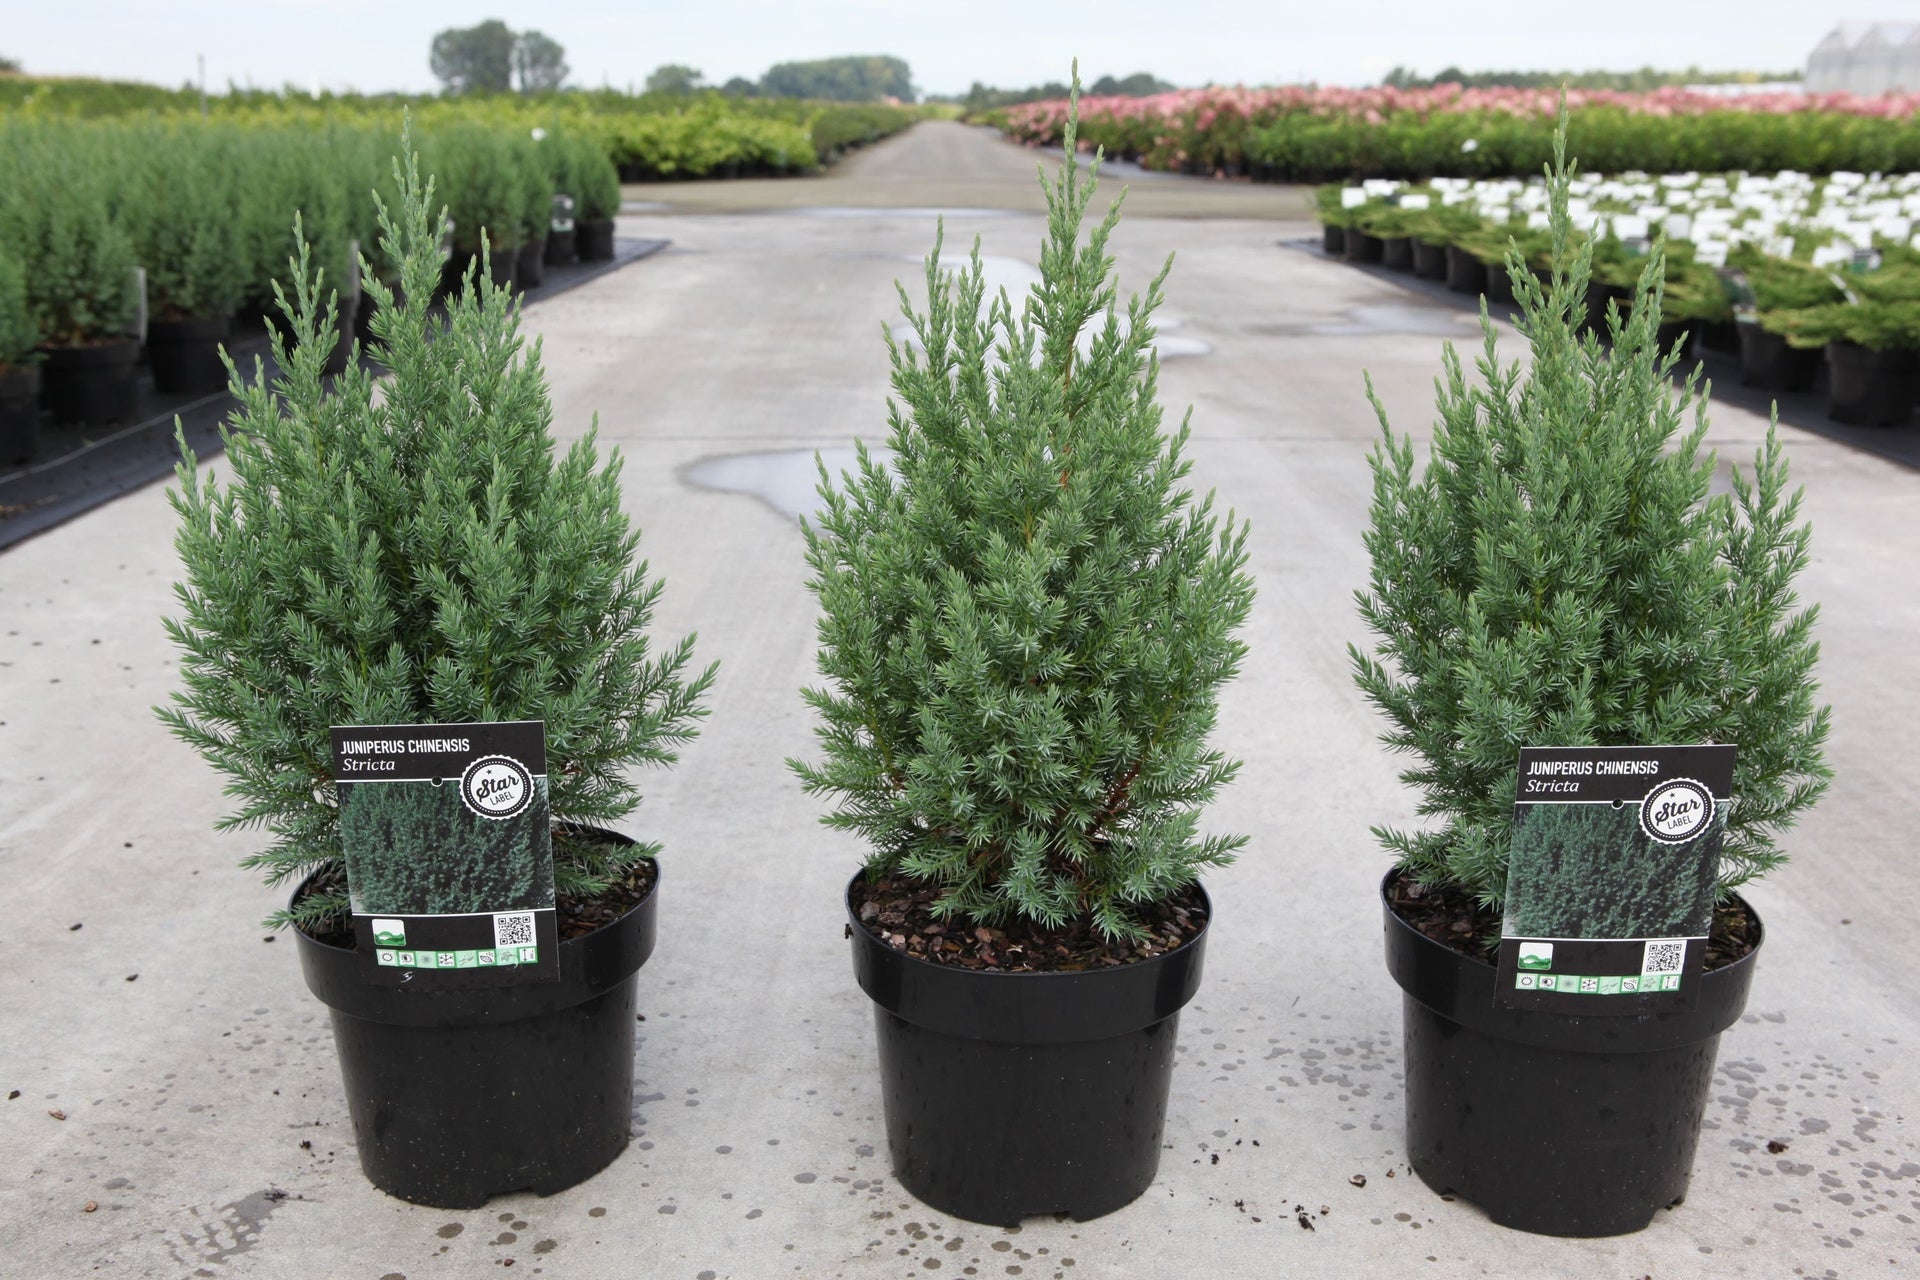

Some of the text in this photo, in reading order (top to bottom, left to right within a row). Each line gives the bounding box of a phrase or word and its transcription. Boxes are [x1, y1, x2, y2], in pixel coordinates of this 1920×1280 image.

[341, 738, 470, 754] JUNIPERUS CHINENSIS
[342, 758, 395, 771] Stricta
[1527, 760, 1659, 775] JUNIPERUS CHINENSIS
[476, 775, 520, 802] Star
[1525, 779, 1580, 793] Stricta
[490, 791, 515, 806] LABEL
[1655, 798, 1701, 825] Star
[1667, 816, 1693, 830] LABEL
